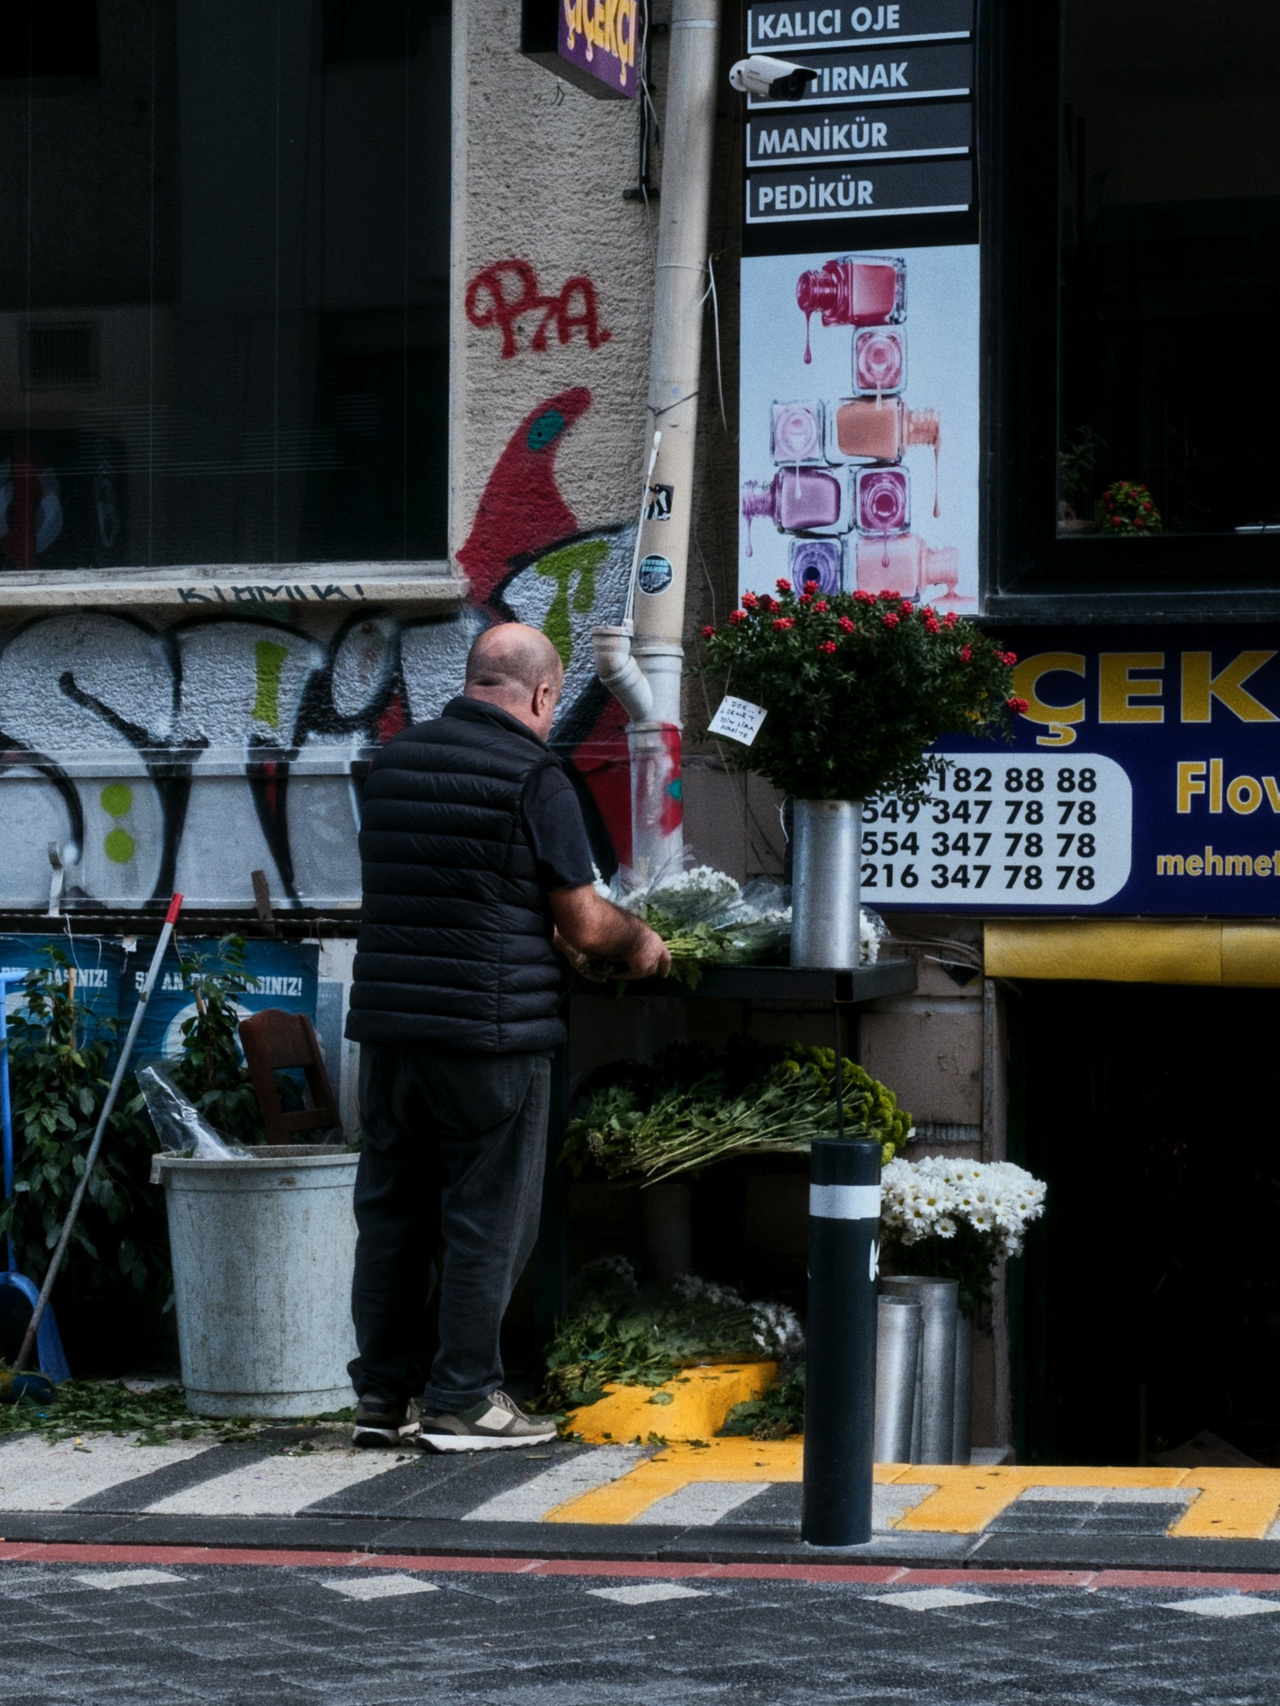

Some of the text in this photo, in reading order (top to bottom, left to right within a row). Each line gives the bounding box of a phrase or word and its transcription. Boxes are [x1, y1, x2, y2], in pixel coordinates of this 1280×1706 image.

[758, 5, 900, 39] KALICI OJE
[811, 62, 908, 93] TIRNAK
[758, 116, 888, 154] MANİKÜR
[758, 174, 874, 211] PEDİKÜR
[1004, 768, 1044, 793] 88
[1056, 768, 1097, 793] 88
[861, 800, 1097, 826] 549 347 78 78
[861, 831, 1096, 858] 554 347 78 78
[860, 863, 1096, 890] 216 347 78 78
